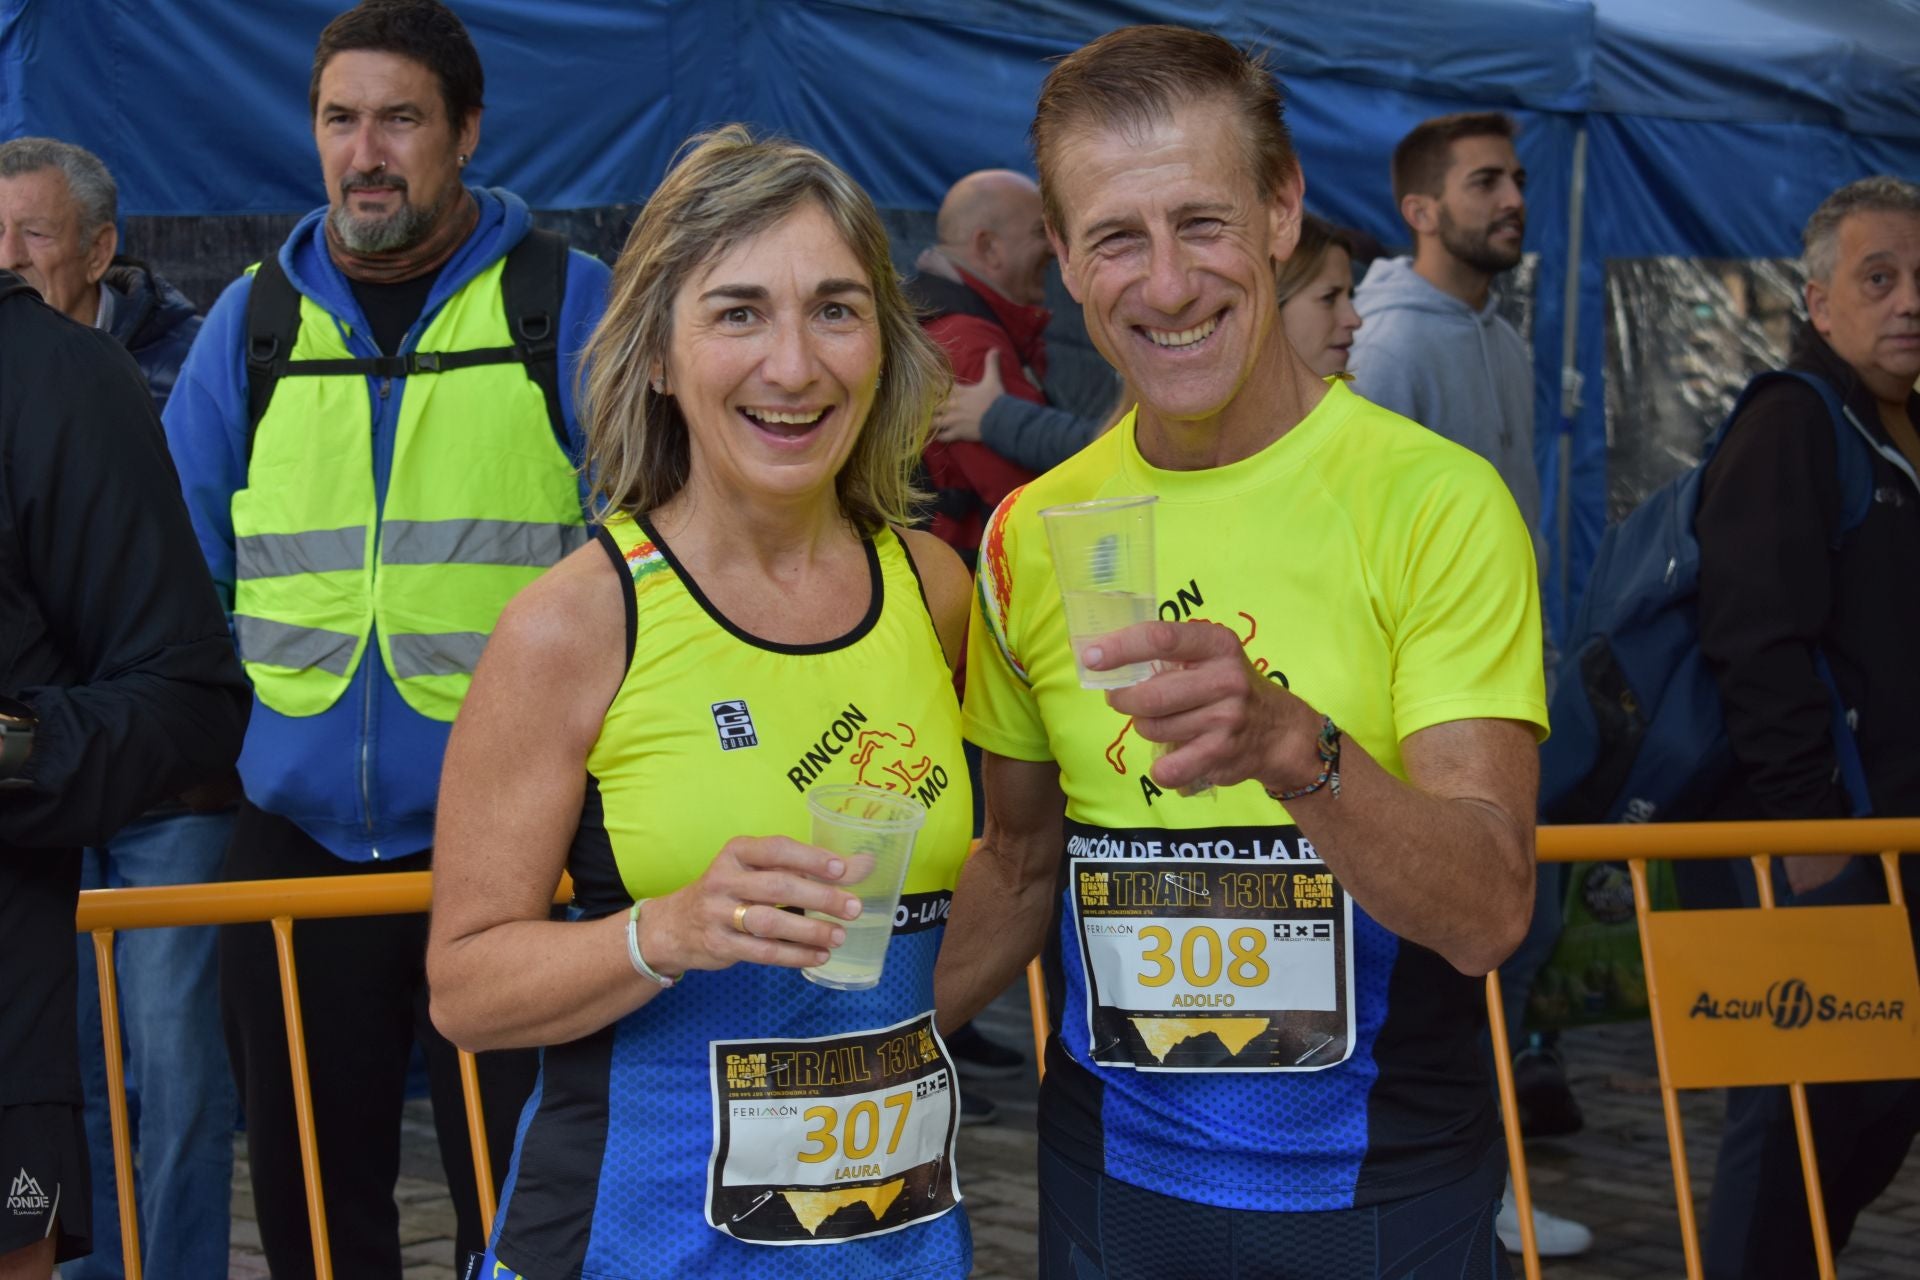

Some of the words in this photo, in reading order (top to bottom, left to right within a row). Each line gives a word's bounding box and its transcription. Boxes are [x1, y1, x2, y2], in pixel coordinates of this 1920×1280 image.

[787, 703, 868, 794] RINCON
[1067, 833, 1126, 859] RINCÓN
[1130, 841, 1162, 859] DE
[1112, 871, 1212, 907] TRAIL
[1218, 872, 1289, 909] 13K
[1137, 925, 1270, 988] 308
[1172, 993, 1235, 1008] ADOLFO
[1690, 992, 1763, 1019] ALQUI
[1817, 995, 1905, 1021] SAGAR
[772, 1046, 871, 1087] TRAIL
[797, 1091, 913, 1164] 307
[834, 1164, 882, 1181] LAURA
